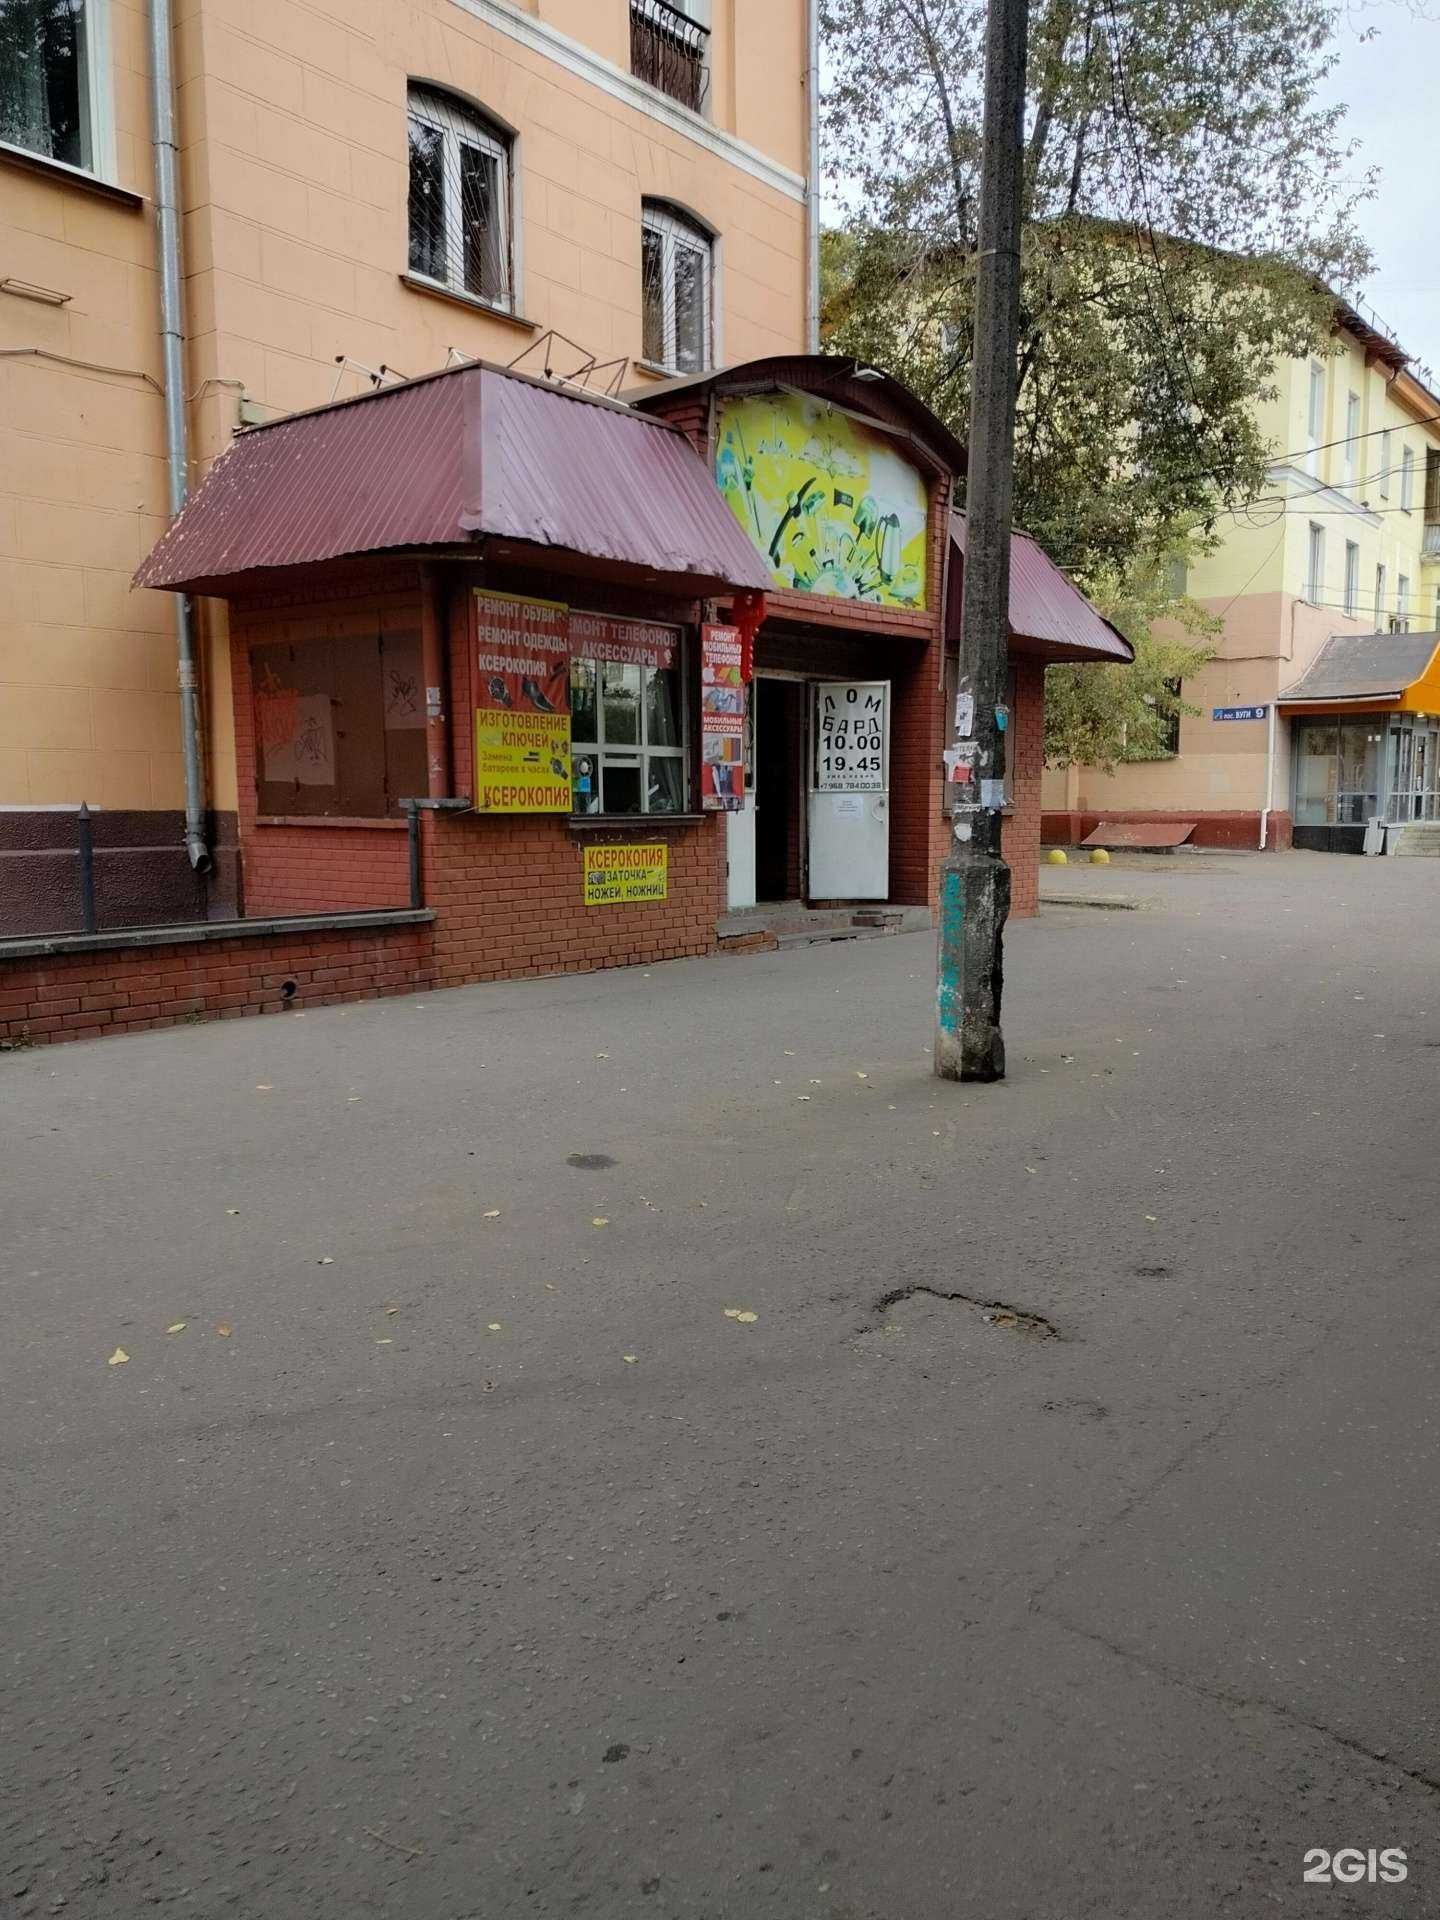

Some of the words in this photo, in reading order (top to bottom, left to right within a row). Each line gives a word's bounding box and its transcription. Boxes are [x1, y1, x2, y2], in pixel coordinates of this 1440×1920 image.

[477, 597, 520, 617] РЕМОНТ
[523, 605, 555, 623] ОБУВИ
[478, 625, 520, 646] РЕМОНТ
[523, 632, 567, 653] ОДЕЖДЫ
[611, 623, 677, 647] ТЕЛЕФОНОВ
[581, 641, 657, 665] АКСЕССУАРЫ
[478, 654, 547, 676] КСЕРОКОПИЯ
[480, 711, 568, 731] ИЗГОТОВЛЕНИЕ
[1255, 708, 1264, 718] 9
[823, 735, 881, 751] 10.00
[823, 756, 881, 772] 19.45
[483, 785, 570, 807] КСЕРОКОПИЯ
[588, 848, 664, 868] КСЕРОКОПИЯ
[606, 869, 647, 881] ЗАТОЧКА
[626, 884, 664, 897] НОЖНИЦ
